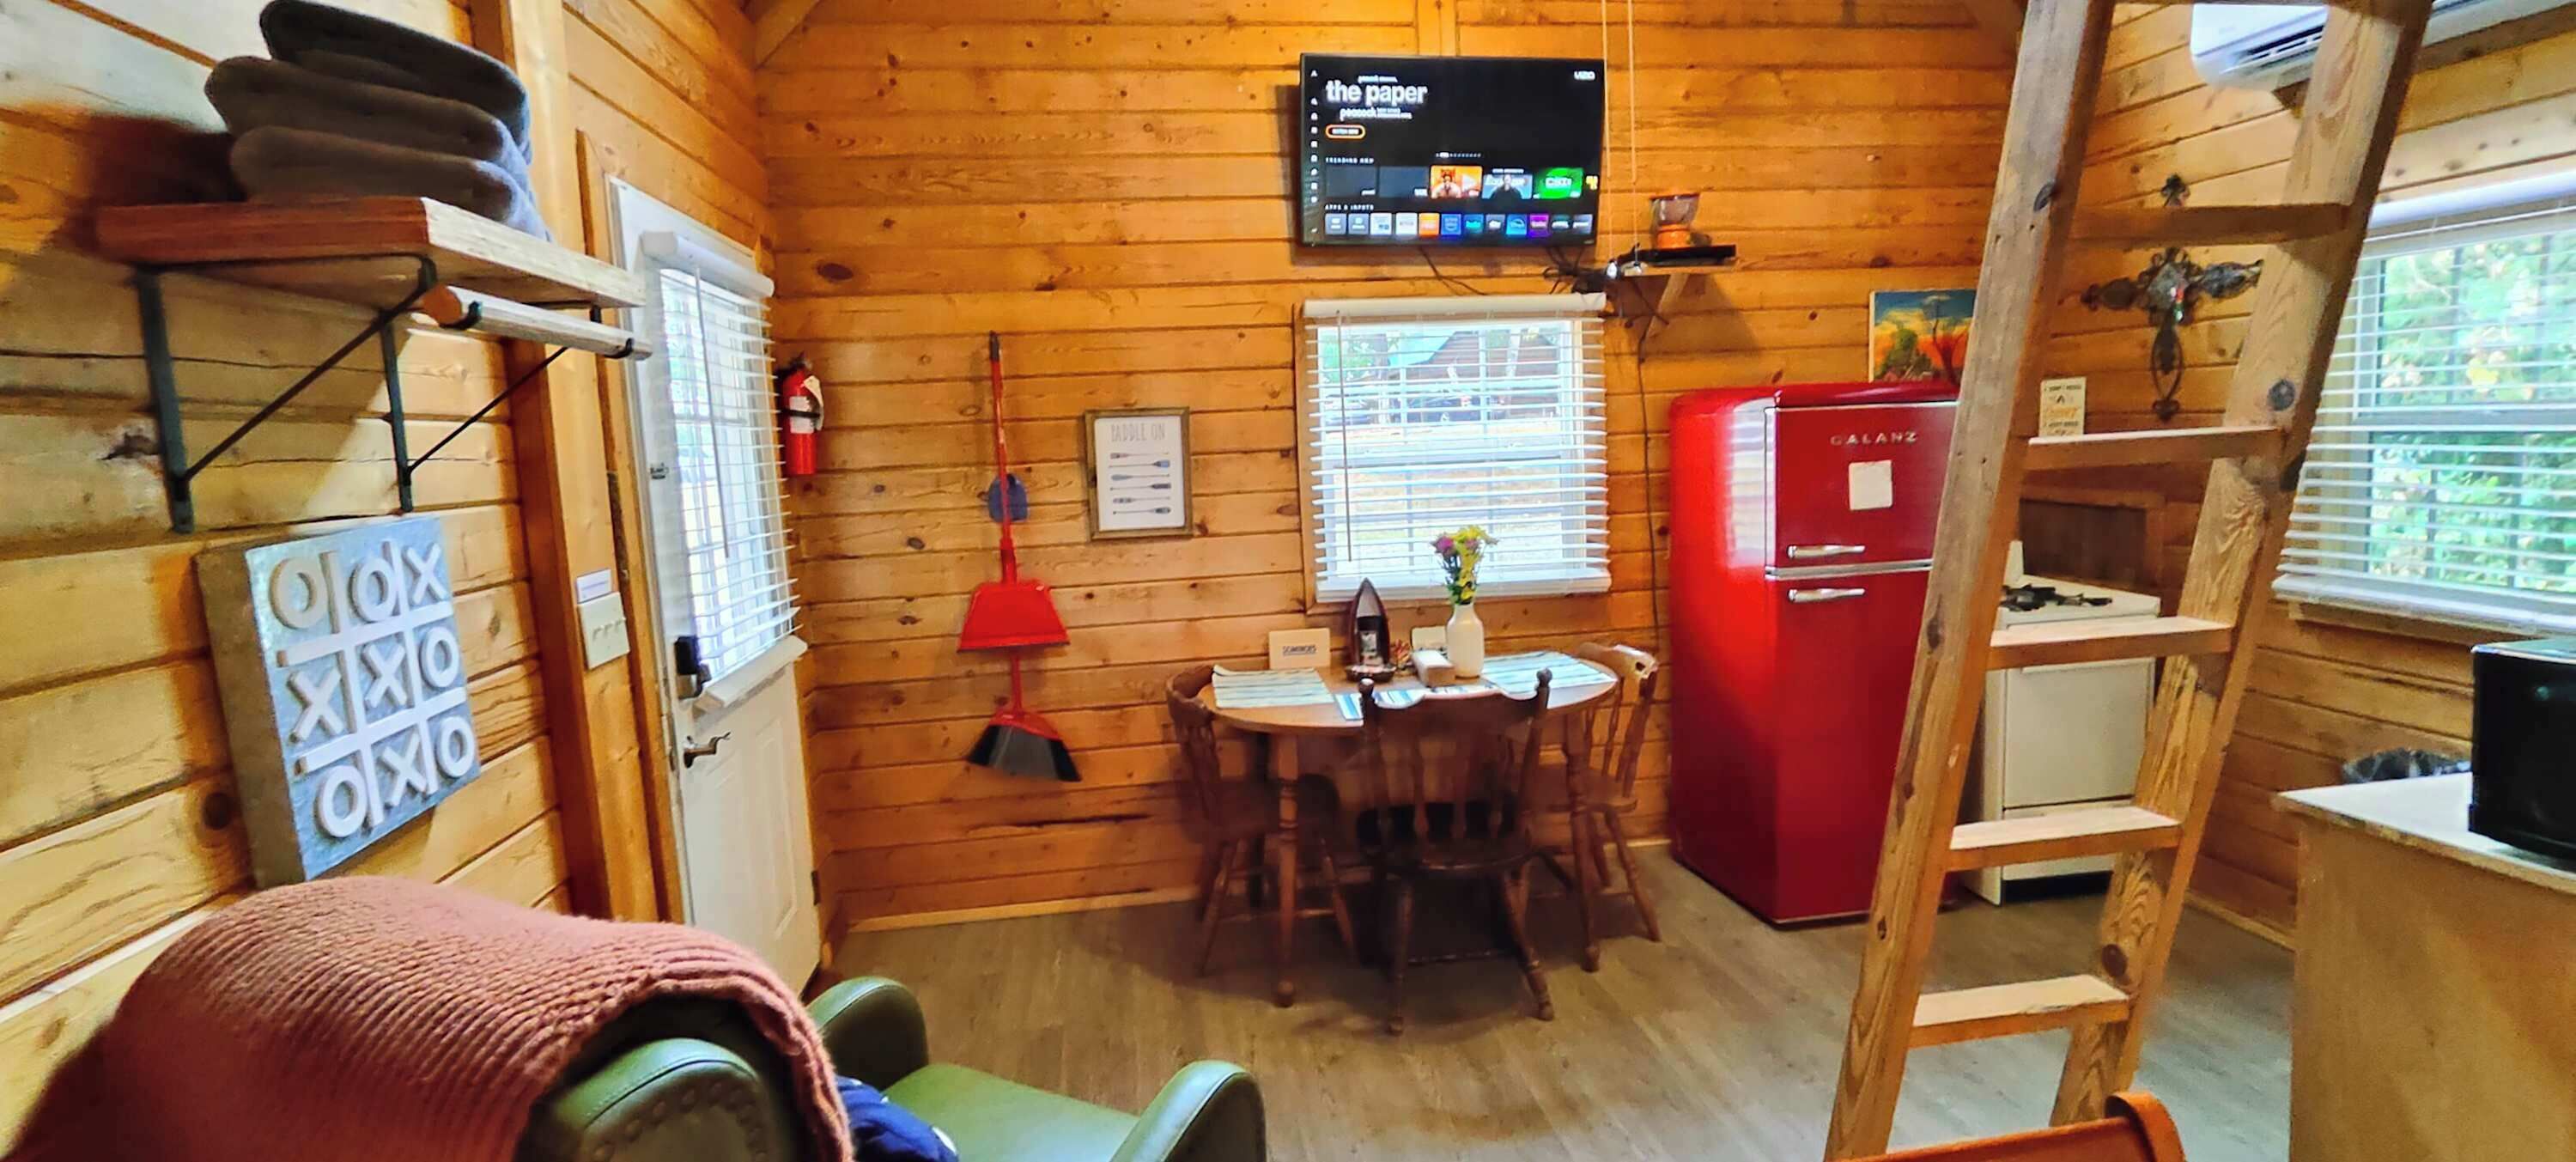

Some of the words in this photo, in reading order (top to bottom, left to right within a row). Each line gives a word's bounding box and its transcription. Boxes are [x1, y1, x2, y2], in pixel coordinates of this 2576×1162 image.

[1326, 79, 1362, 103] the
[1365, 84, 1428, 107] paper
[1110, 423, 1147, 442] PADDLE
[1151, 422, 1166, 441] ON
[1830, 431, 1918, 446] GALANZ
